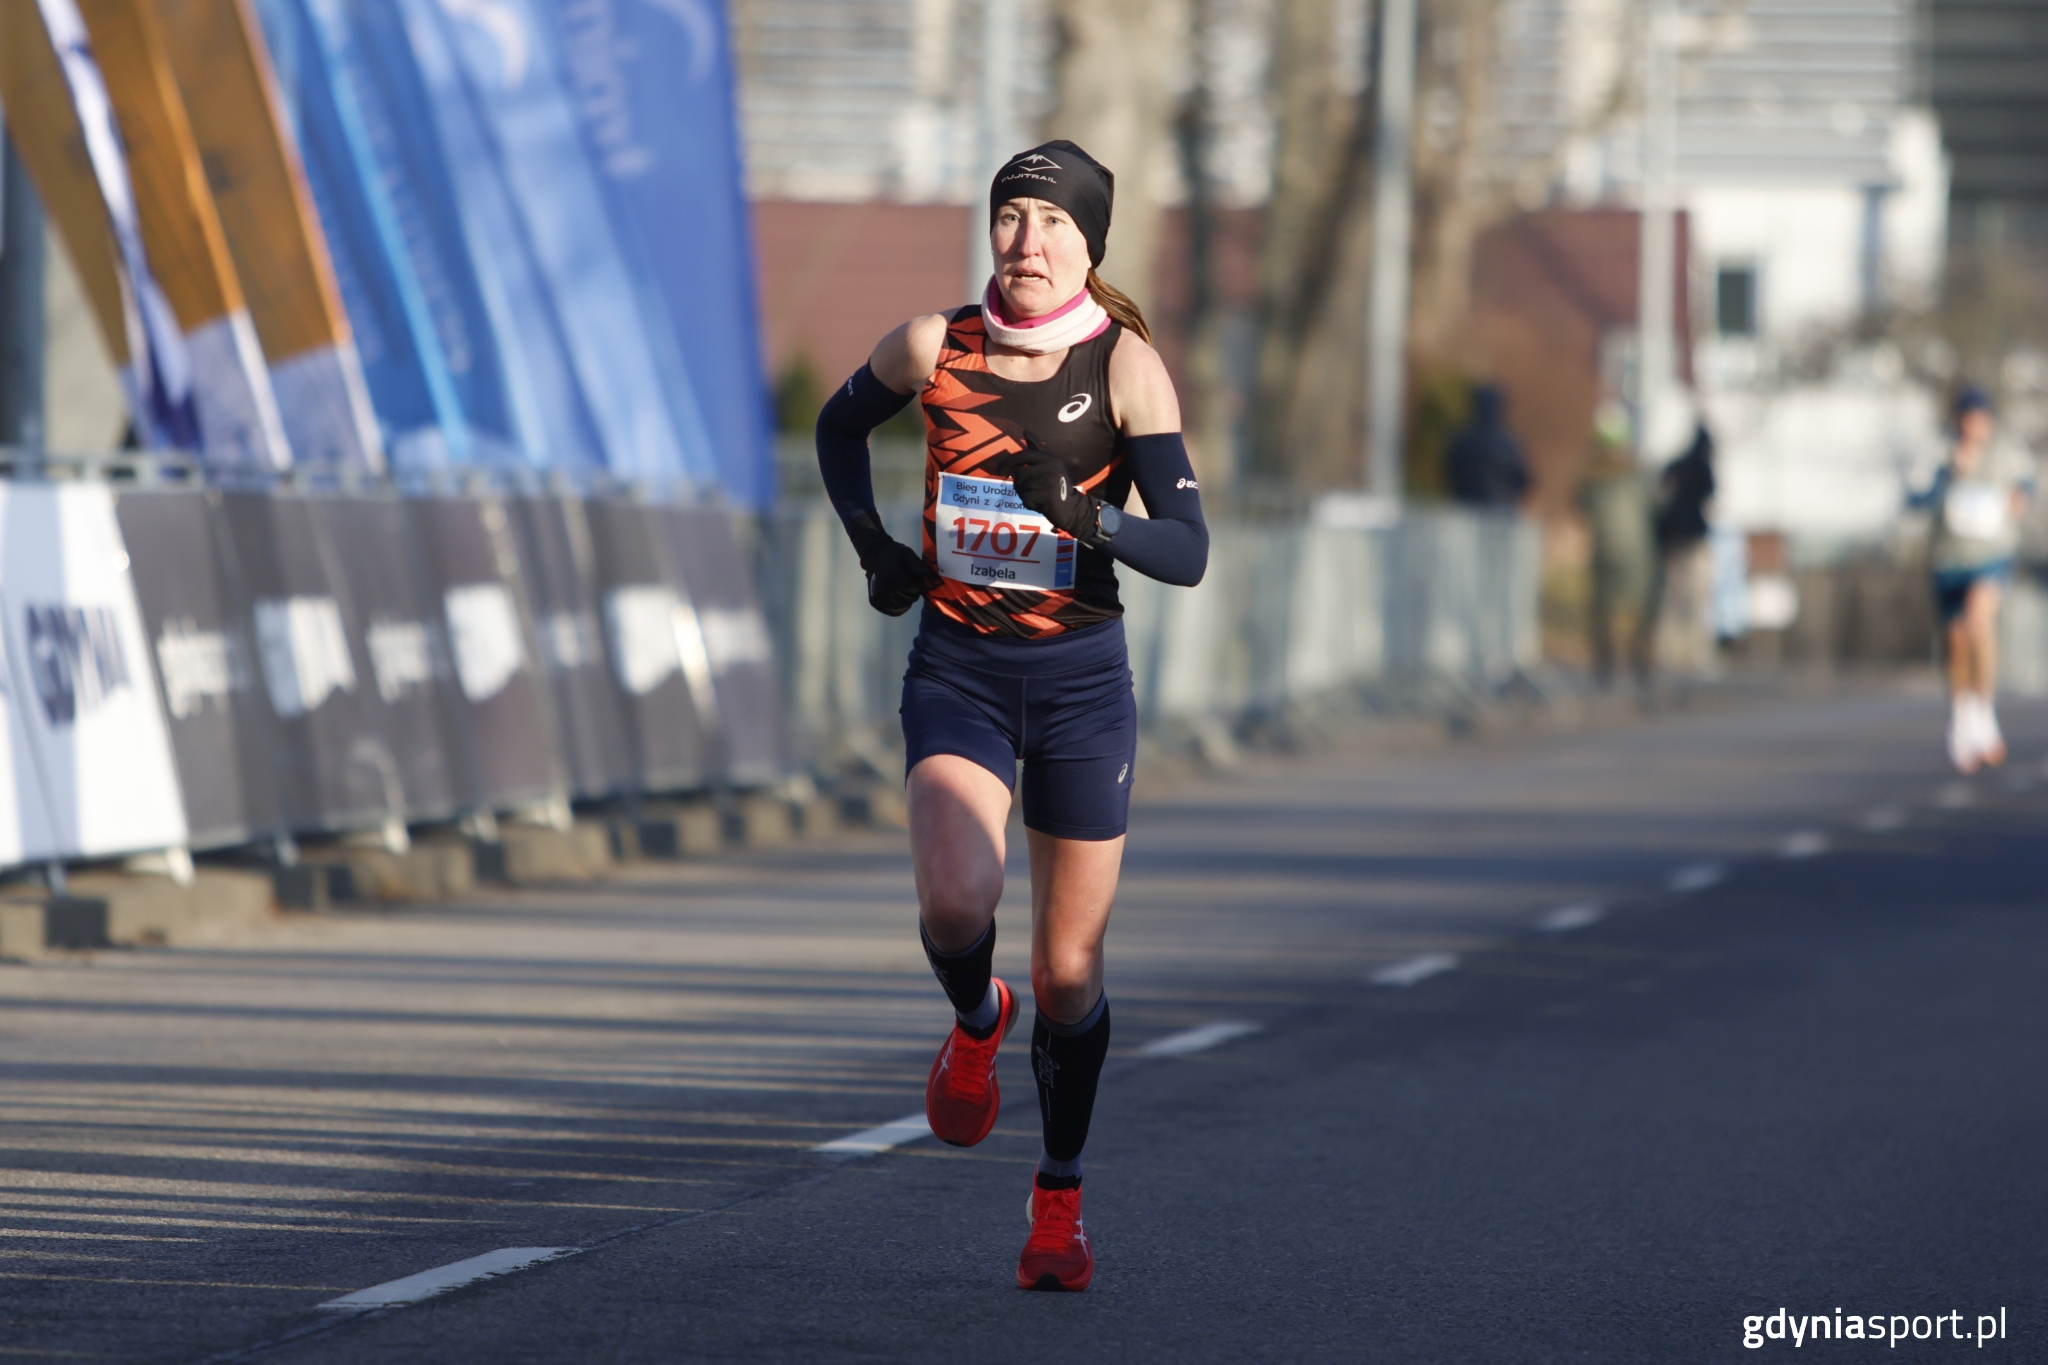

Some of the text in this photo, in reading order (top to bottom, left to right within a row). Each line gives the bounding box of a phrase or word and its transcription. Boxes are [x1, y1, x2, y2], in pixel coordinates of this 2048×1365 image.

[1001, 173, 1057, 184] FUJITRAIL
[956, 482, 978, 494] Bieg
[952, 493, 980, 505] Gdyni
[984, 498, 990, 506] z
[953, 516, 1041, 557] 1707
[970, 564, 1016, 580] Izabela
